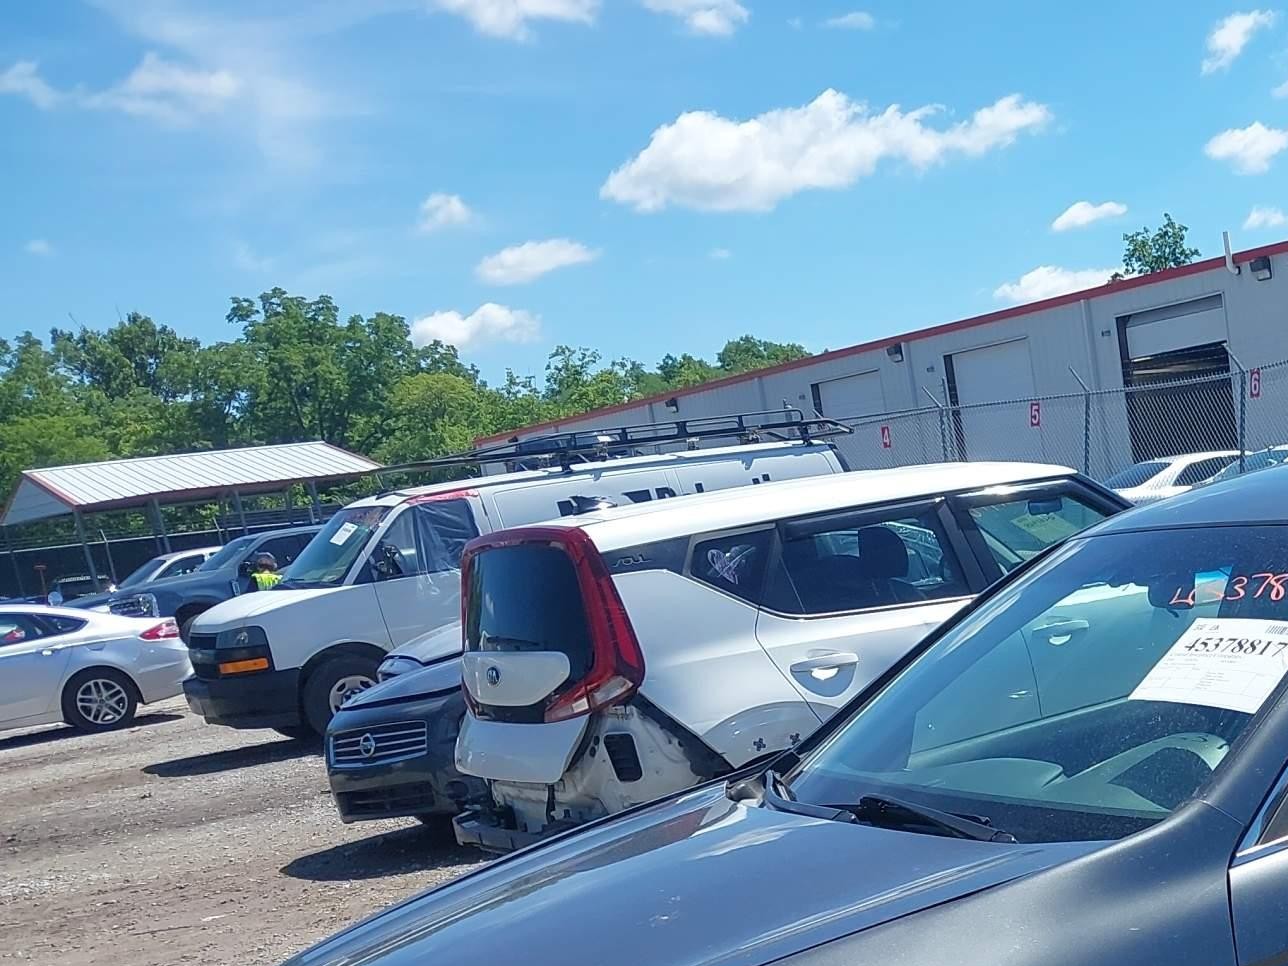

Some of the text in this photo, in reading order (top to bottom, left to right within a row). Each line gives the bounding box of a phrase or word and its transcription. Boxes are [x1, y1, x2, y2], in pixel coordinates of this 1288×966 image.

[1251, 373, 1260, 395] 6
[1031, 405, 1040, 424] 5
[882, 428, 891, 447] 4
